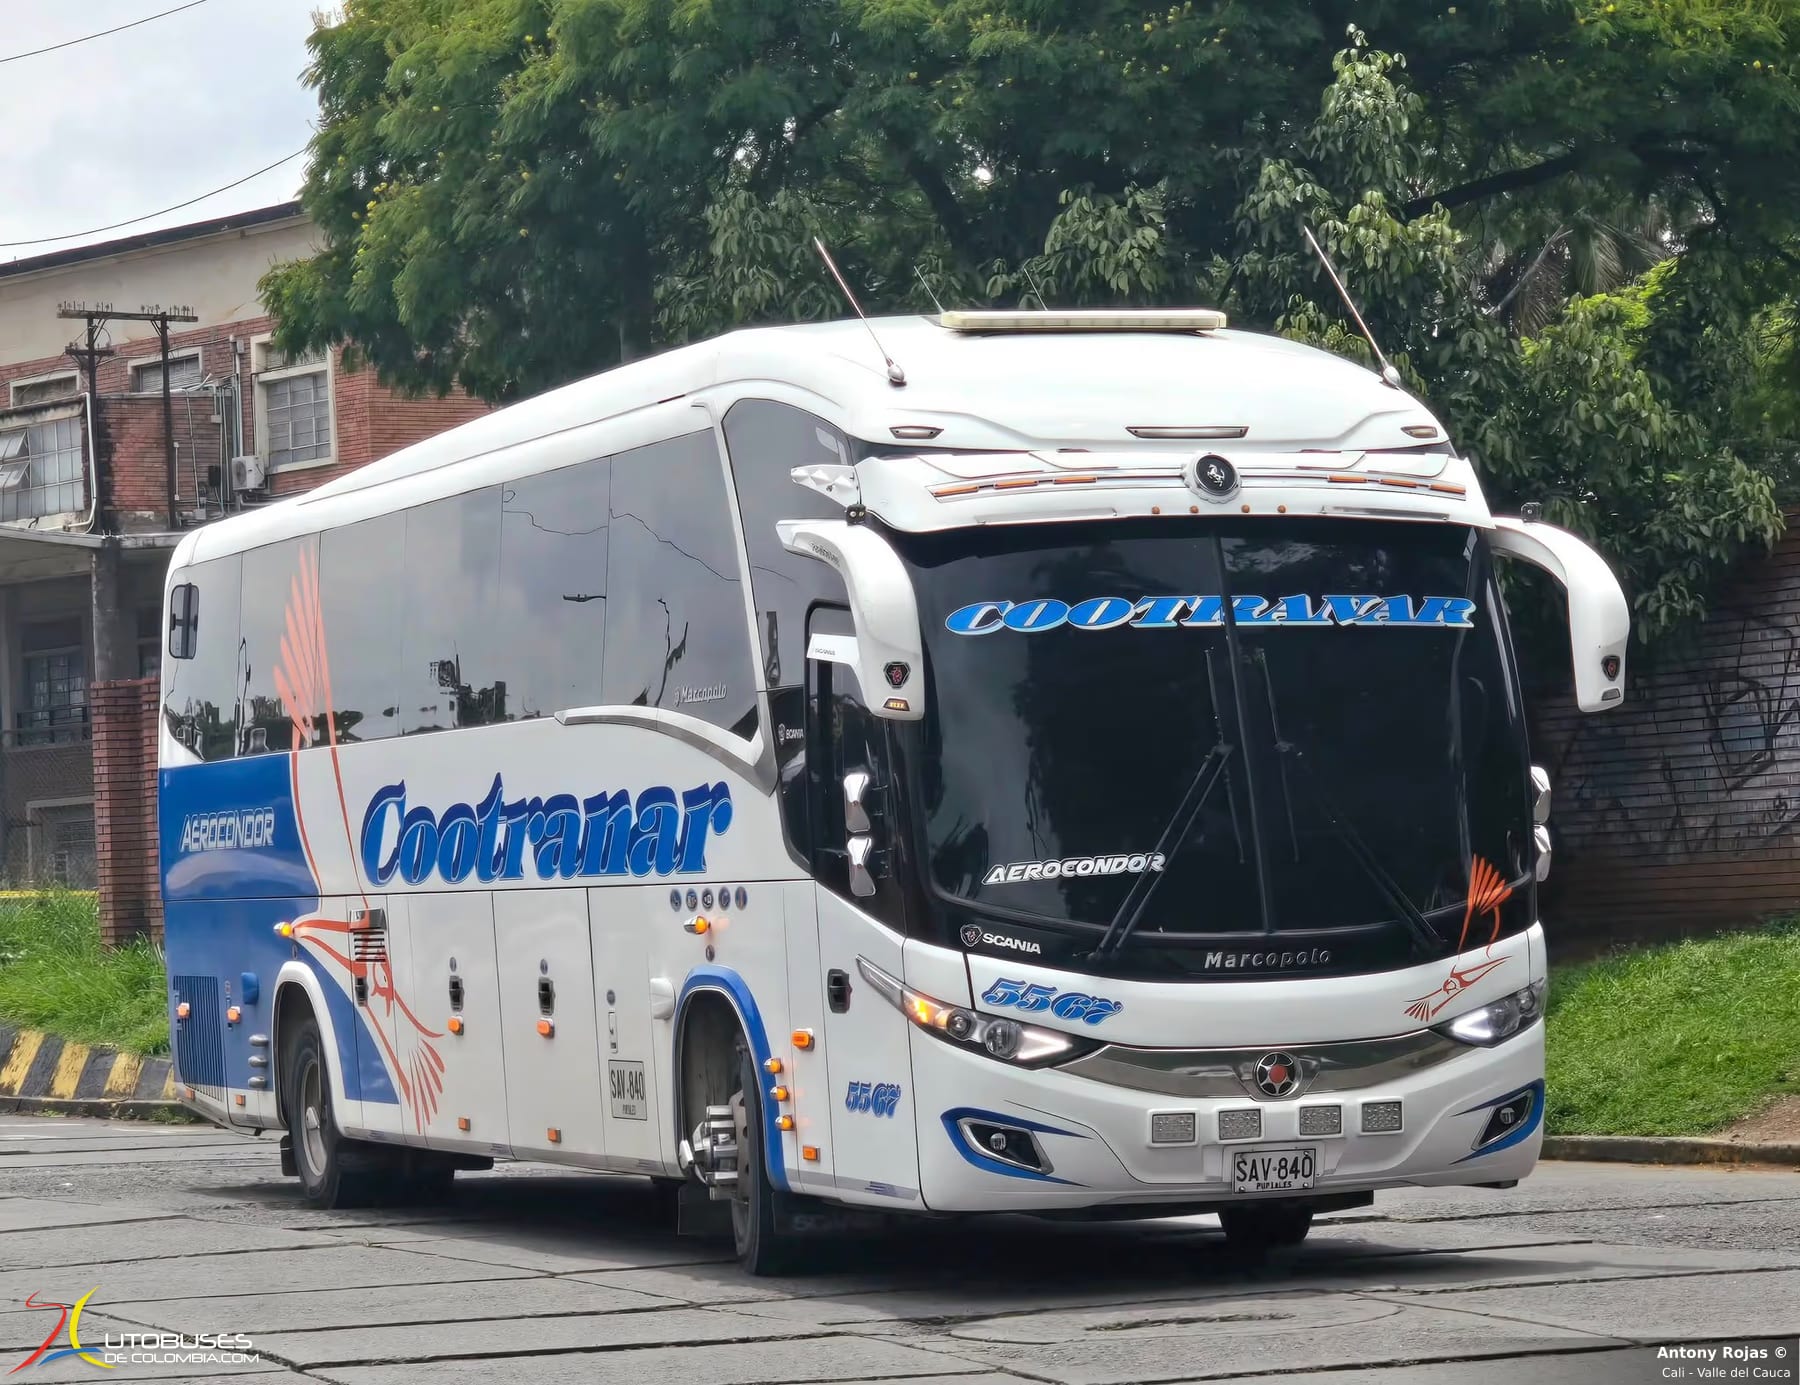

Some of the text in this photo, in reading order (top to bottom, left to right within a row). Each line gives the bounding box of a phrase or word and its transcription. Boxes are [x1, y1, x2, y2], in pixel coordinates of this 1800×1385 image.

[945, 595, 1476, 635] COOTRANAR
[681, 682, 728, 703] Marcopolo
[785, 728, 804, 739] SCANIA
[179, 806, 275, 852] AEROCONDOR
[360, 772, 733, 887] Cootranar
[981, 852, 1166, 885] AEROCONDOR
[982, 933, 1041, 954] SCANIA
[1204, 948, 1331, 969] Marcopolo
[981, 977, 1124, 1026] 5567
[845, 1080, 902, 1118] 5567
